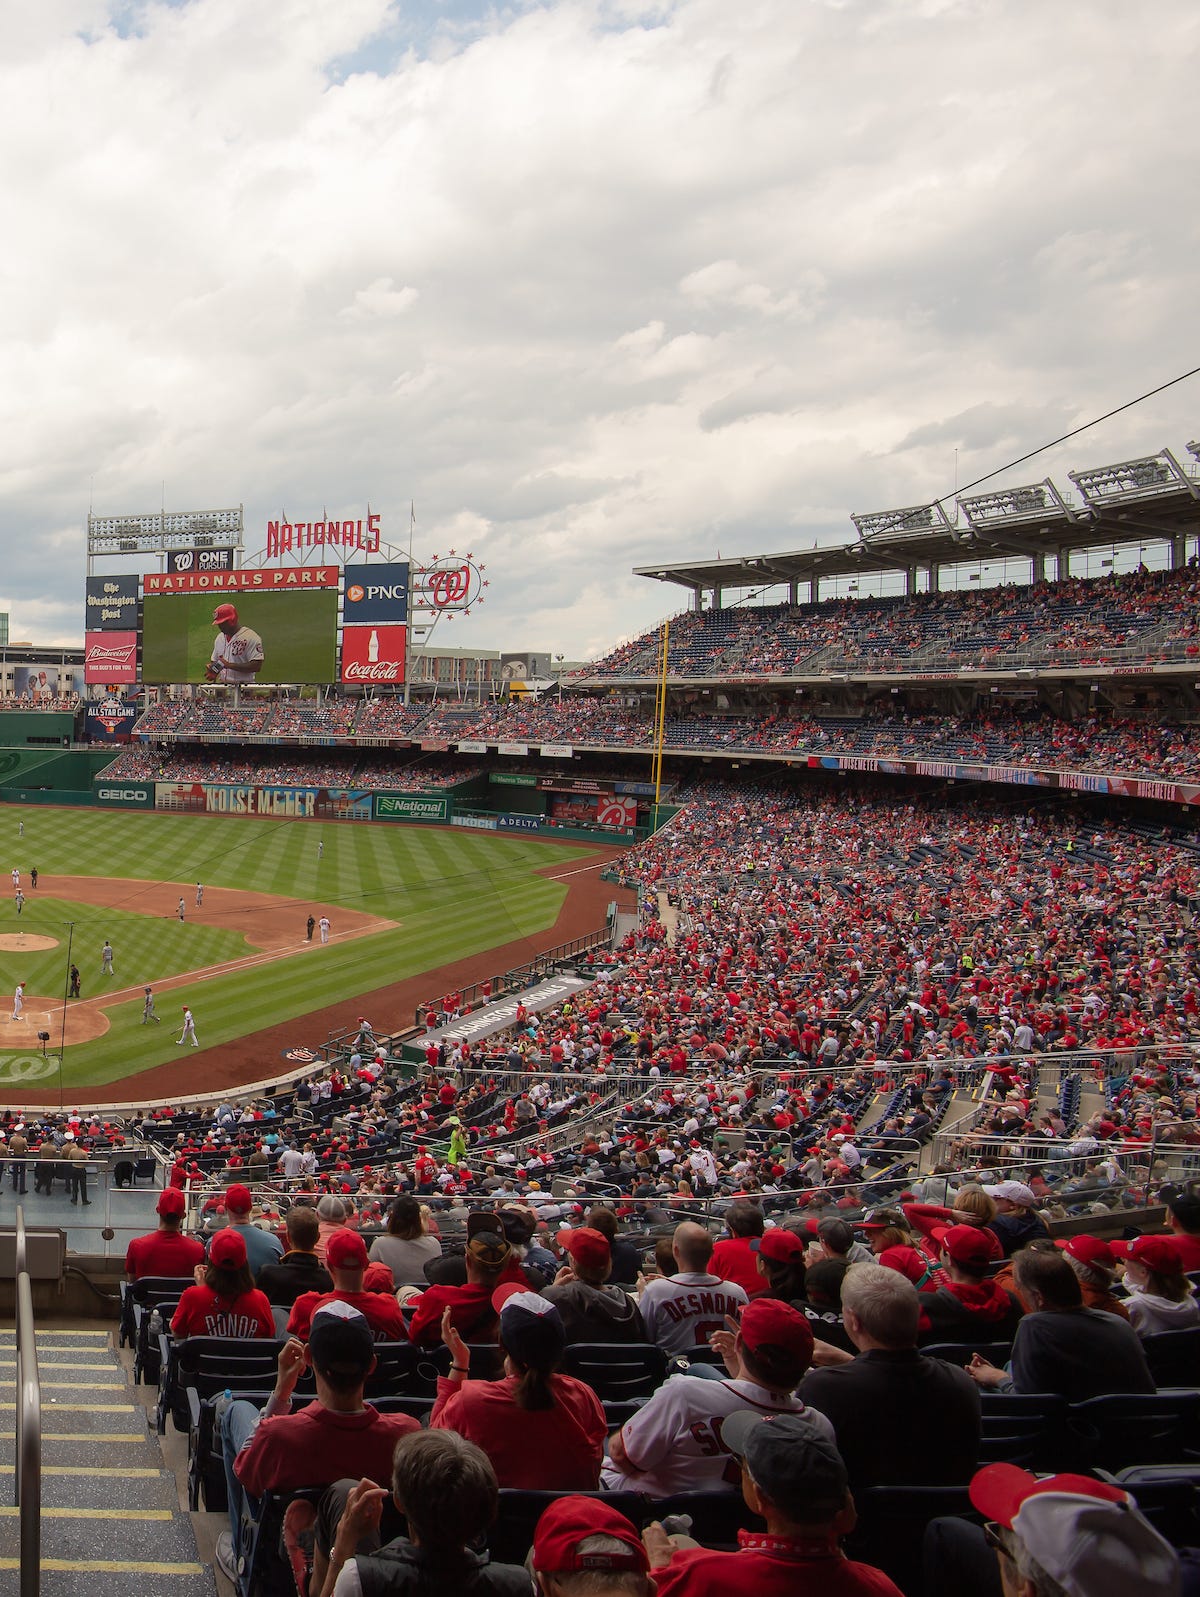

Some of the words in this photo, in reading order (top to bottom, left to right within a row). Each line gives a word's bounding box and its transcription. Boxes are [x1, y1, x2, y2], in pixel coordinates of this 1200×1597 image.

[267, 514, 380, 558] NATIONALS
[199, 551, 229, 563] ONE
[198, 560, 229, 570] PURSUIT
[150, 573, 263, 589] NATIONALS
[273, 570, 327, 584] PARK
[103, 582, 119, 594] The
[366, 585, 405, 600] PNC
[87, 595, 136, 607] Washington
[102, 609, 121, 621] Post
[90, 648, 131, 658] Budweiser
[344, 661, 402, 680] Coca-Cola
[87, 708, 100, 717] ALL
[100, 708, 117, 717] STAR
[117, 708, 135, 717] GAME
[839, 757, 878, 772] NOISEMETER
[915, 761, 957, 777] NOISEMETER
[98, 789, 148, 801] GEICO
[1137, 781, 1176, 801] NOISEMETER
[394, 800, 443, 812] National
[508, 818, 538, 828] DELTA
[442, 1003, 518, 1041] WASHINGTON
[702, 1156, 710, 1167] 7
[204, 1314, 259, 1340] DONOR
